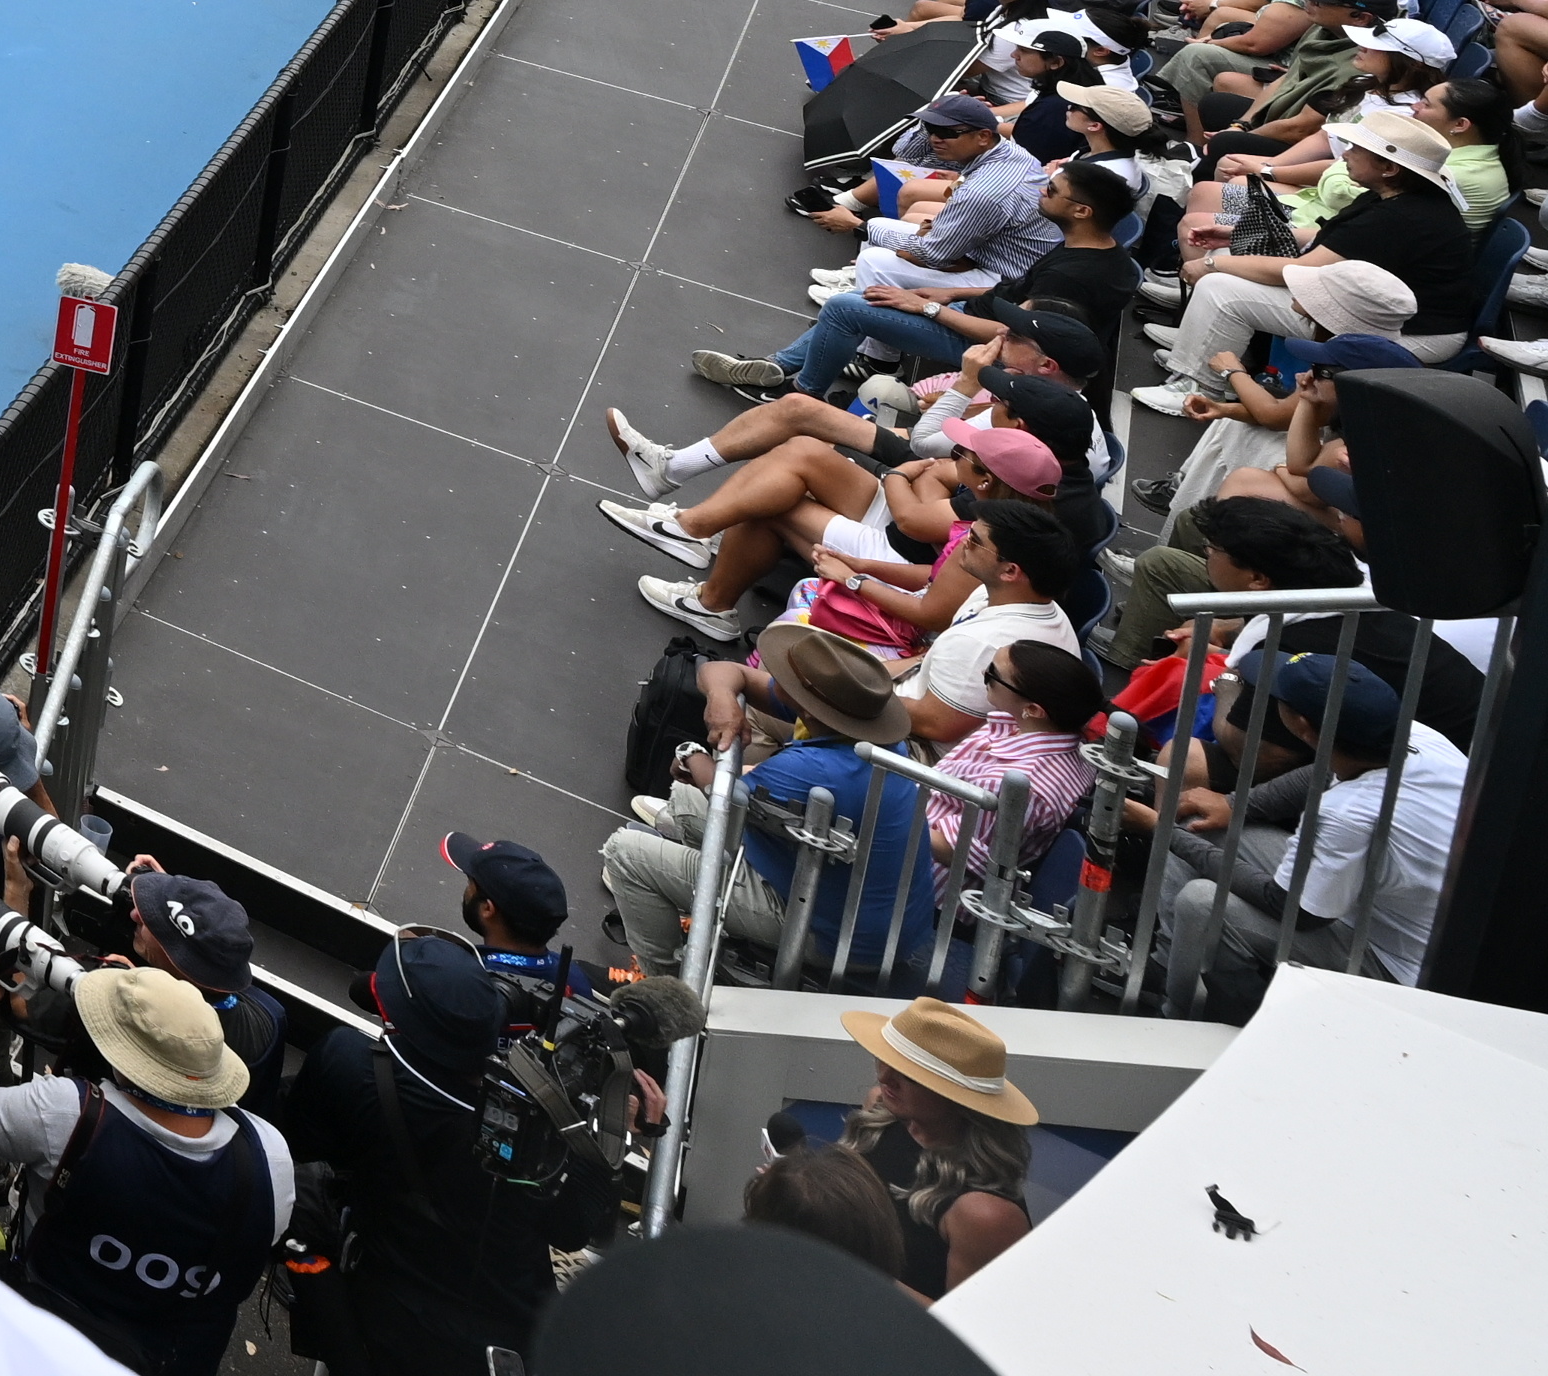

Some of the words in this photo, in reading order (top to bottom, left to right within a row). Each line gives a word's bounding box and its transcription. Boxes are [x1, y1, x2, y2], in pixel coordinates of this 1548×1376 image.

[55, 351, 108, 370] EXTINGUISHER
[74, 347, 91, 357] FIRE
[89, 1234, 222, 1298] 009
